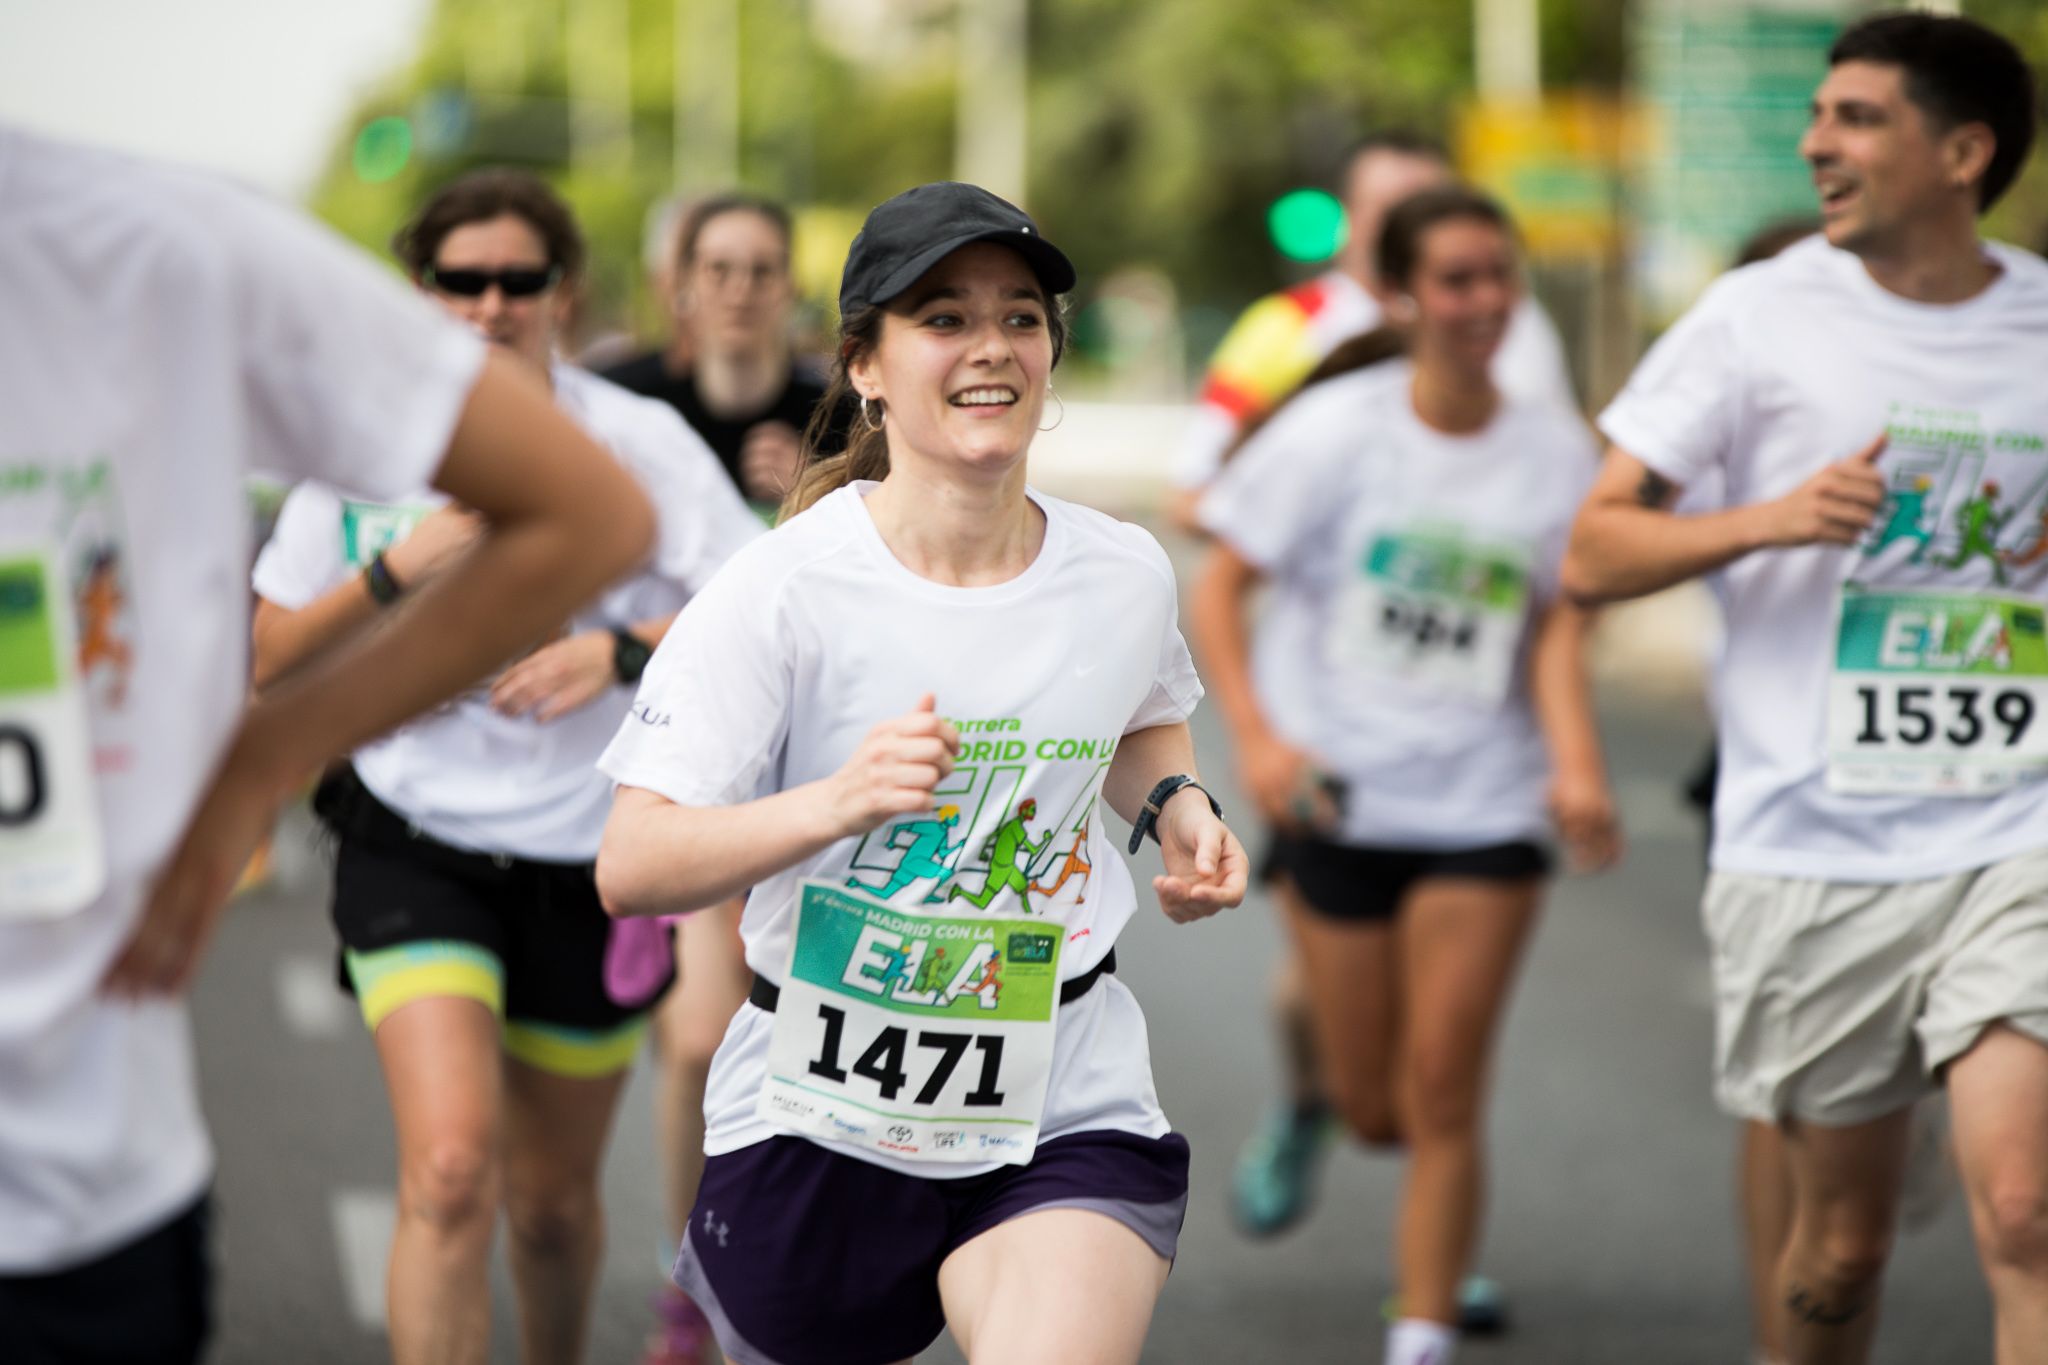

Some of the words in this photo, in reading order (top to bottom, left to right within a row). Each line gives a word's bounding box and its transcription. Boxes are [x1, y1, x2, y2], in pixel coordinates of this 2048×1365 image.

[1880, 610, 2013, 670] ELA
[944, 717, 1022, 734] arrera
[1856, 685, 2036, 748] 1539
[1035, 738, 1097, 761] CON
[865, 908, 932, 939] MADRID
[934, 924, 971, 940] CON
[973, 926, 995, 941] LA
[841, 923, 1001, 1010] ELA
[808, 1003, 1005, 1107] 1471
